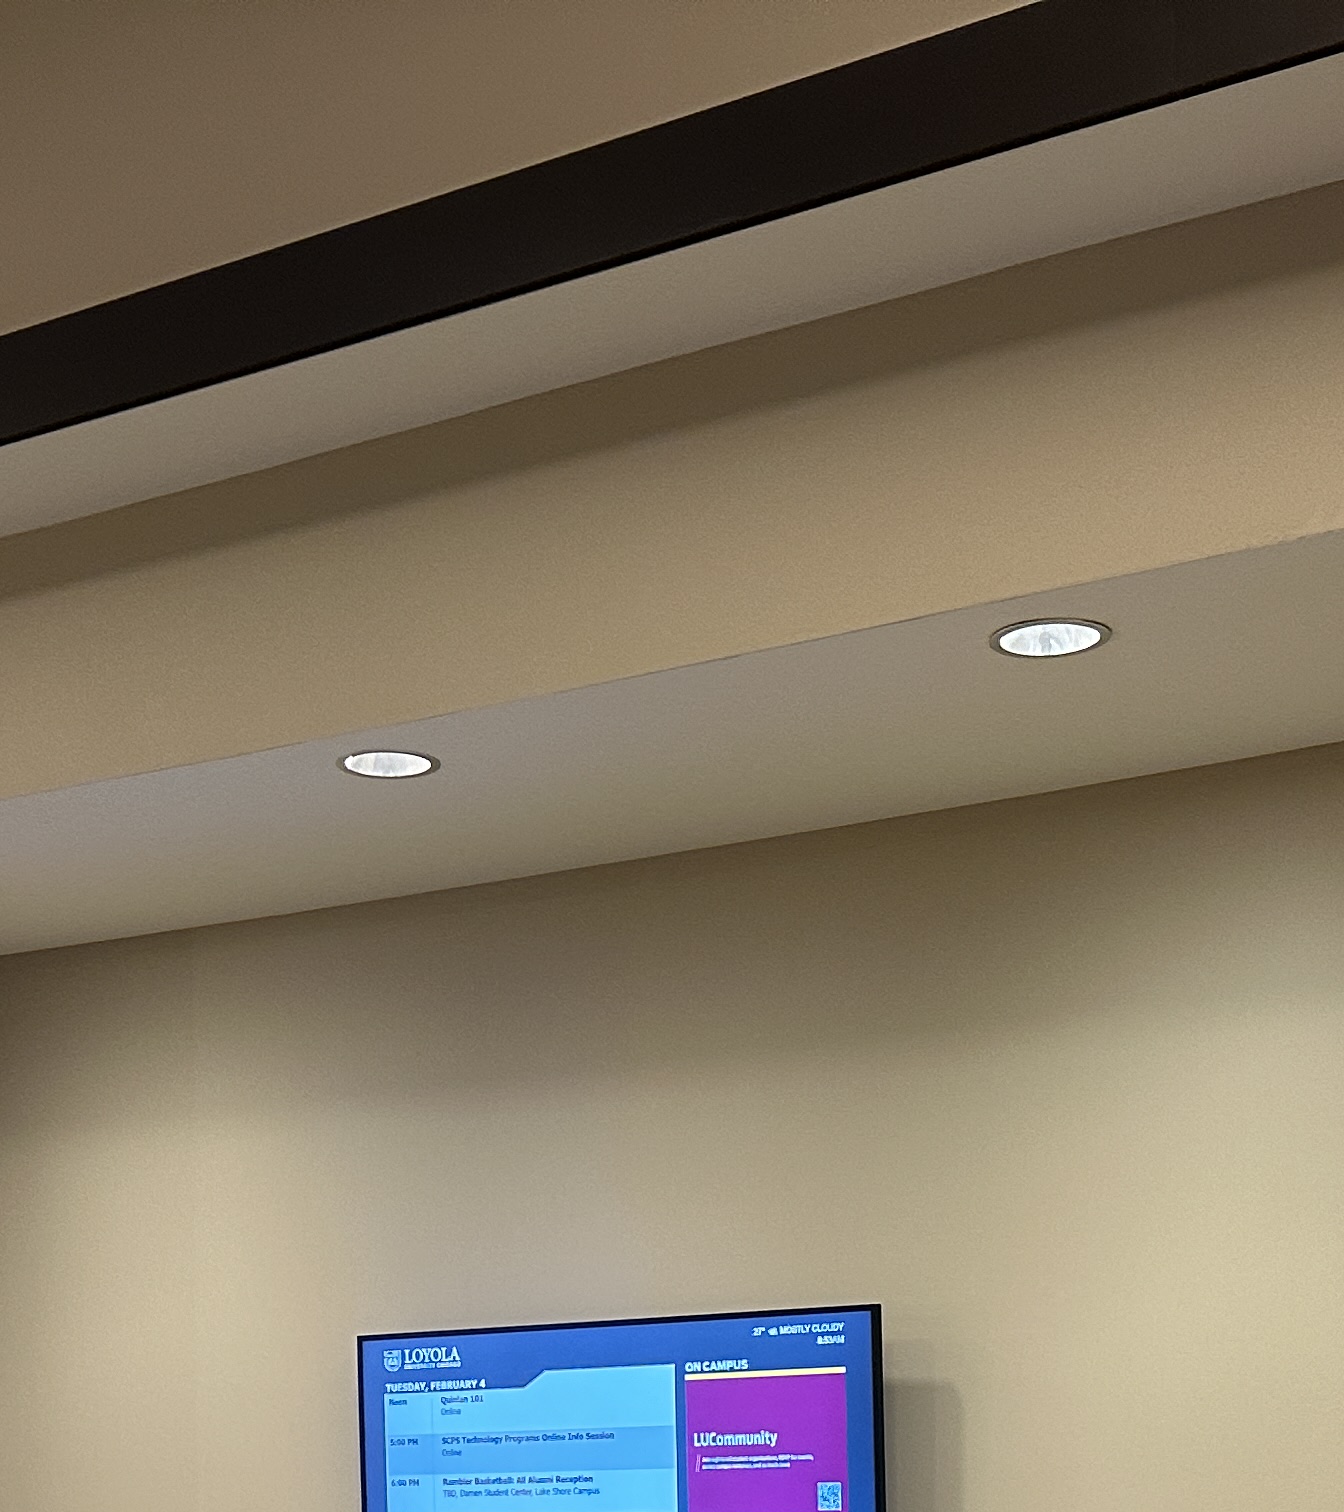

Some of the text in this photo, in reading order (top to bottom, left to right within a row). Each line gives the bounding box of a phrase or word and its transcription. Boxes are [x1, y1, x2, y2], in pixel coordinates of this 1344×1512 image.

[779, 1324, 810, 1335] MOSTLY
[811, 1322, 845, 1333] CLOUDY
[403, 1346, 460, 1364] LOYOLA
[685, 1359, 749, 1372] ON CAMPUS
[385, 1379, 486, 1393] TUESDAY, FEBRUARY 4
[470, 1395, 484, 1403] 101
[407, 1438, 419, 1446] PM
[462, 1436, 503, 1445] Technology
[567, 1432, 584, 1441] Info
[585, 1431, 615, 1440] Session
[693, 1430, 778, 1447] LUCommunity
[408, 1479, 420, 1487] PM
[555, 1474, 594, 1485] Reception
[552, 1487, 572, 1496] Shore
[572, 1486, 601, 1496] Campus
